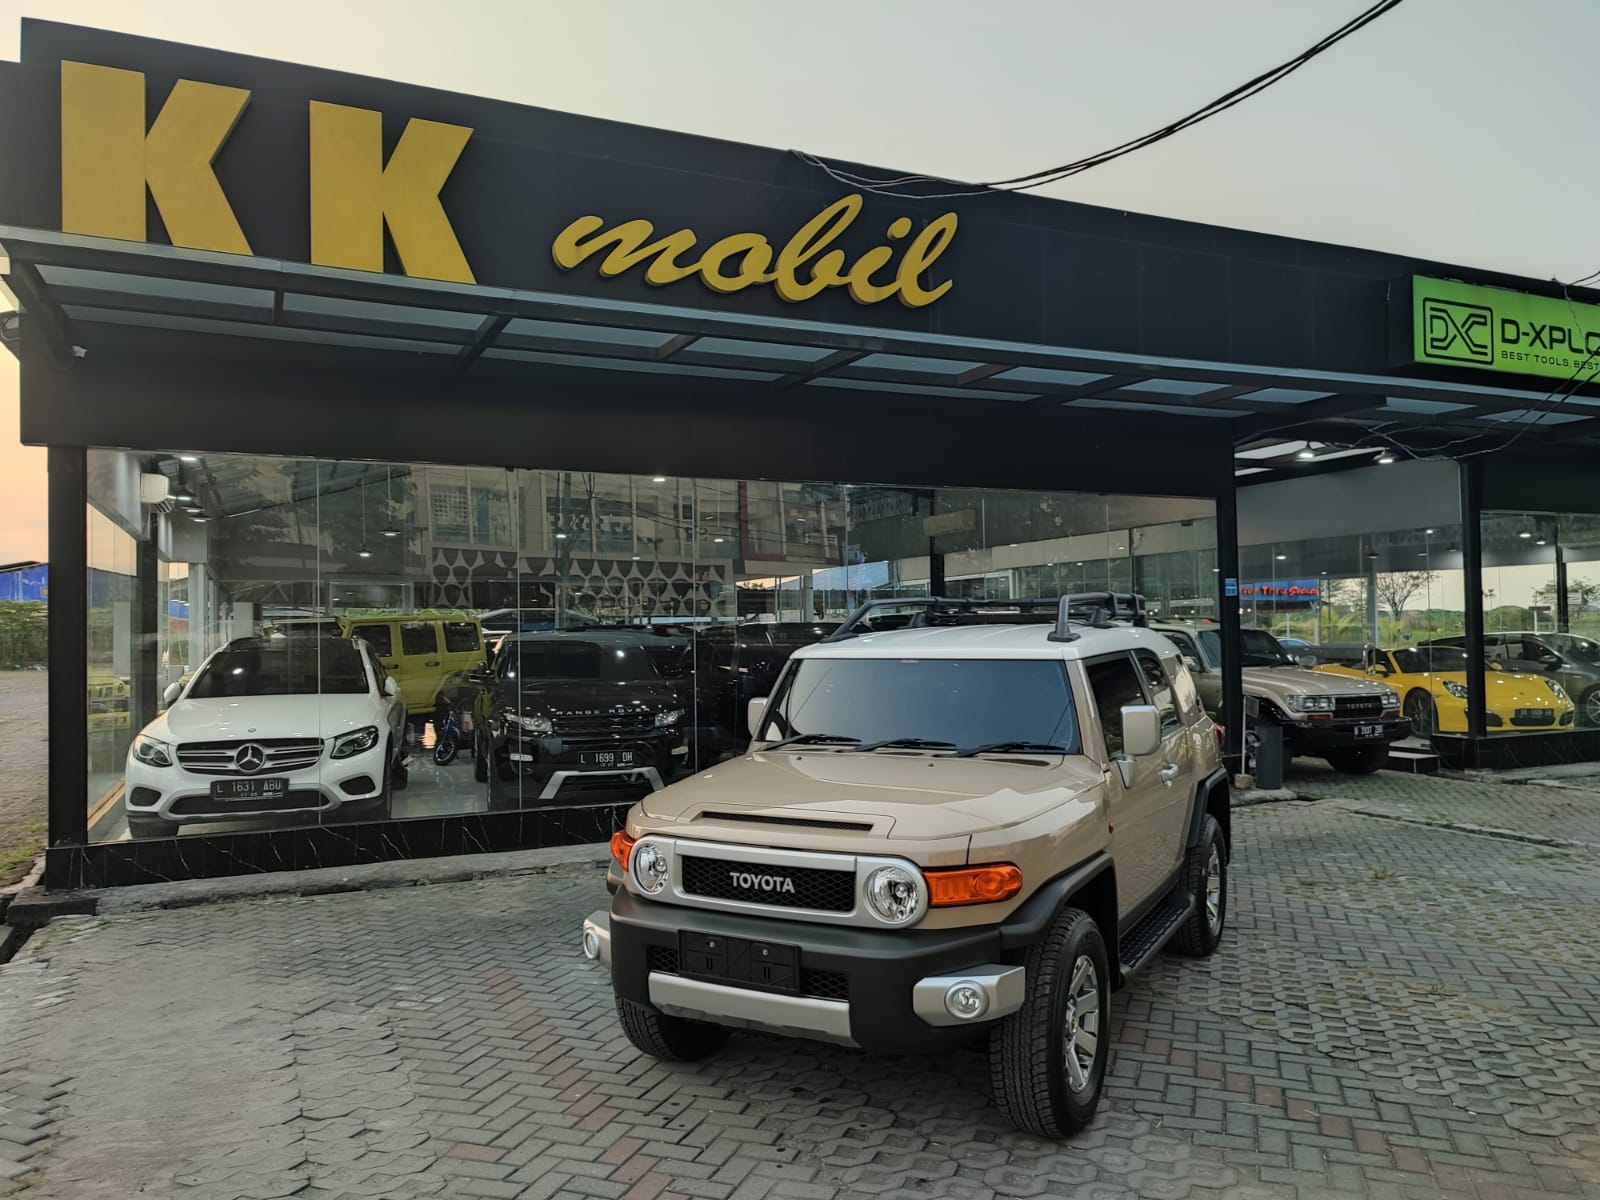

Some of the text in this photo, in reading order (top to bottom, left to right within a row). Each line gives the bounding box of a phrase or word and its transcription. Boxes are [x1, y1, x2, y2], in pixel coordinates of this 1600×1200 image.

[552, 193, 959, 308] mobil
[1501, 350, 1530, 362] BEST
[1534, 354, 1572, 369] TOOLS,
[580, 751, 633, 764] L 1699 DH
[216, 783, 224, 793] L
[232, 780, 255, 792] 1631
[729, 872, 796, 894] TOYOTA
